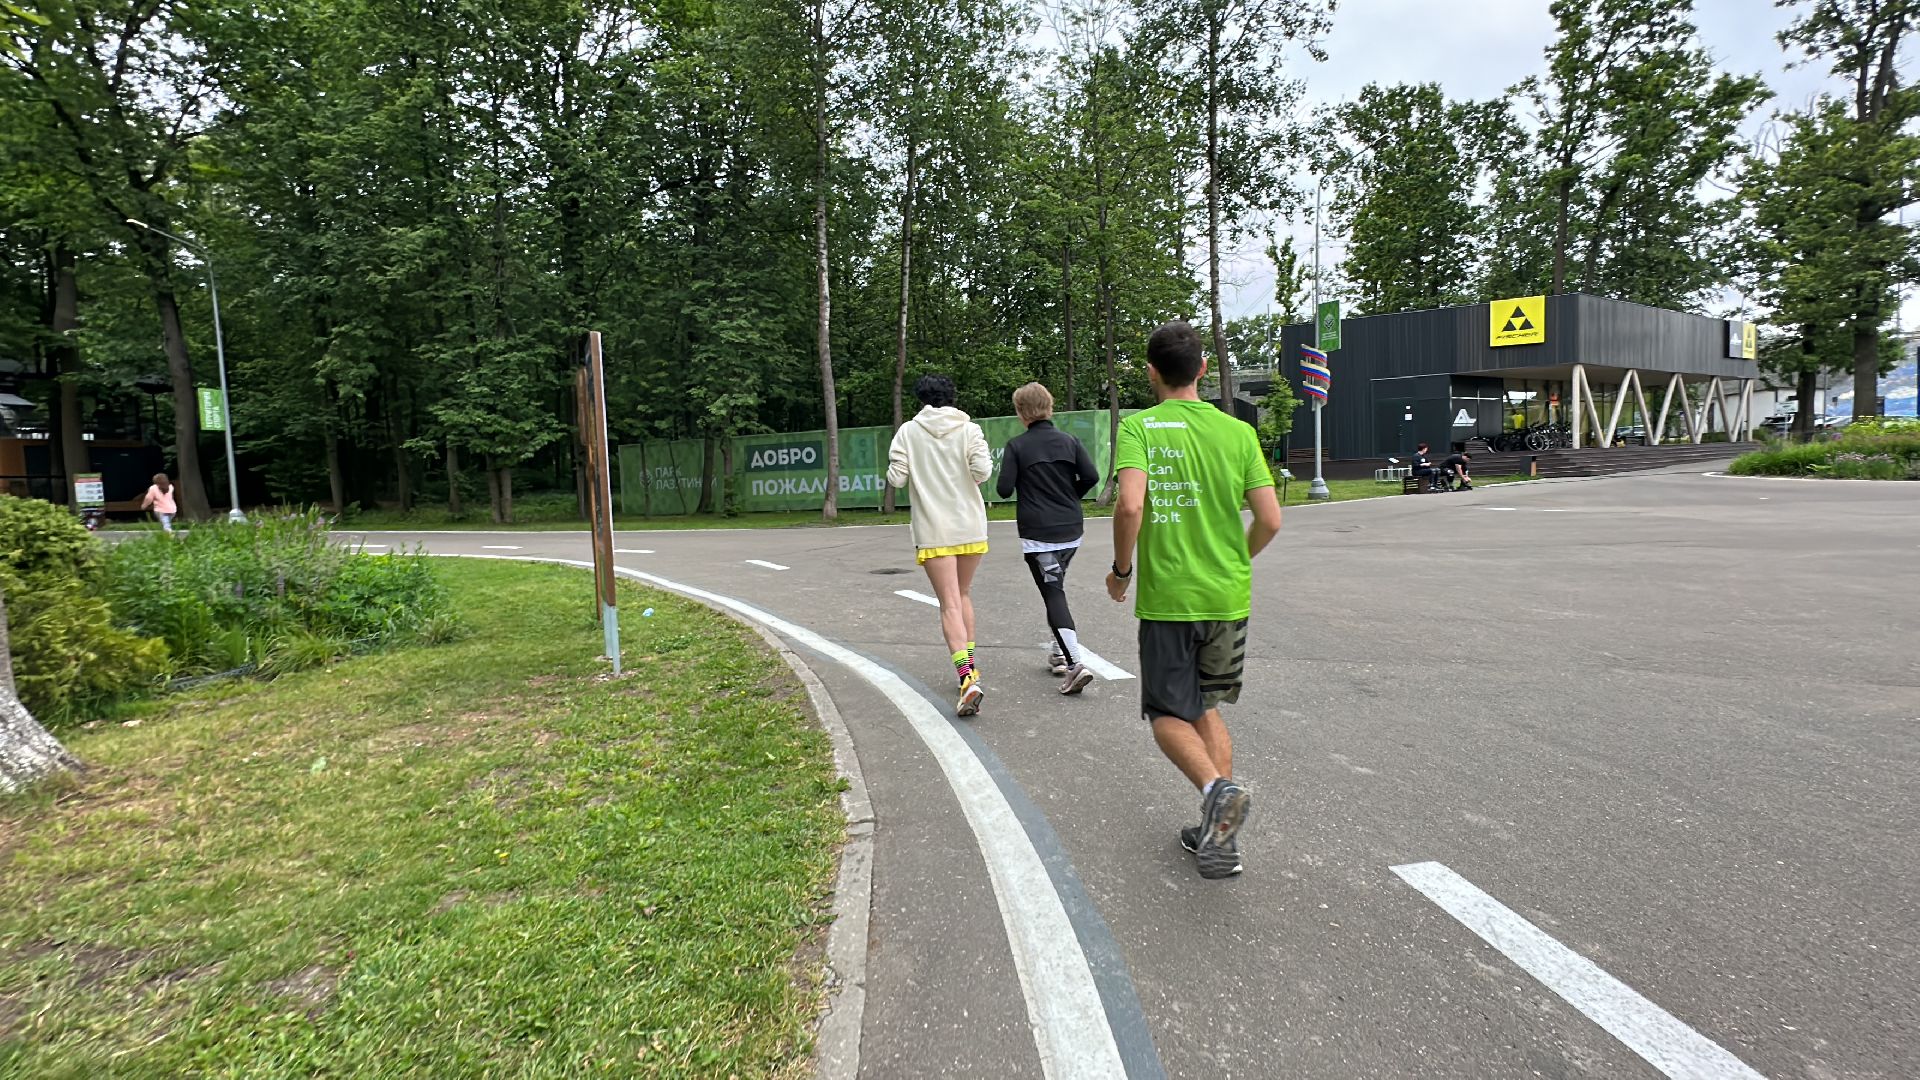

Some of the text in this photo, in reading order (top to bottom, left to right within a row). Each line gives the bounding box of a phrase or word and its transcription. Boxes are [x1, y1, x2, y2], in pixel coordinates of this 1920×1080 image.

[751, 446, 817, 469] ДОБРО
[1148, 446, 1185, 459] If You
[655, 465, 682, 478] ПАРК
[1148, 463, 1173, 475] Can
[655, 476, 718, 490] ЛАЗТИНА
[1148, 479, 1192, 491] Dream
[1149, 494, 1201, 507] You Can
[1150, 511, 1182, 524] Do It
